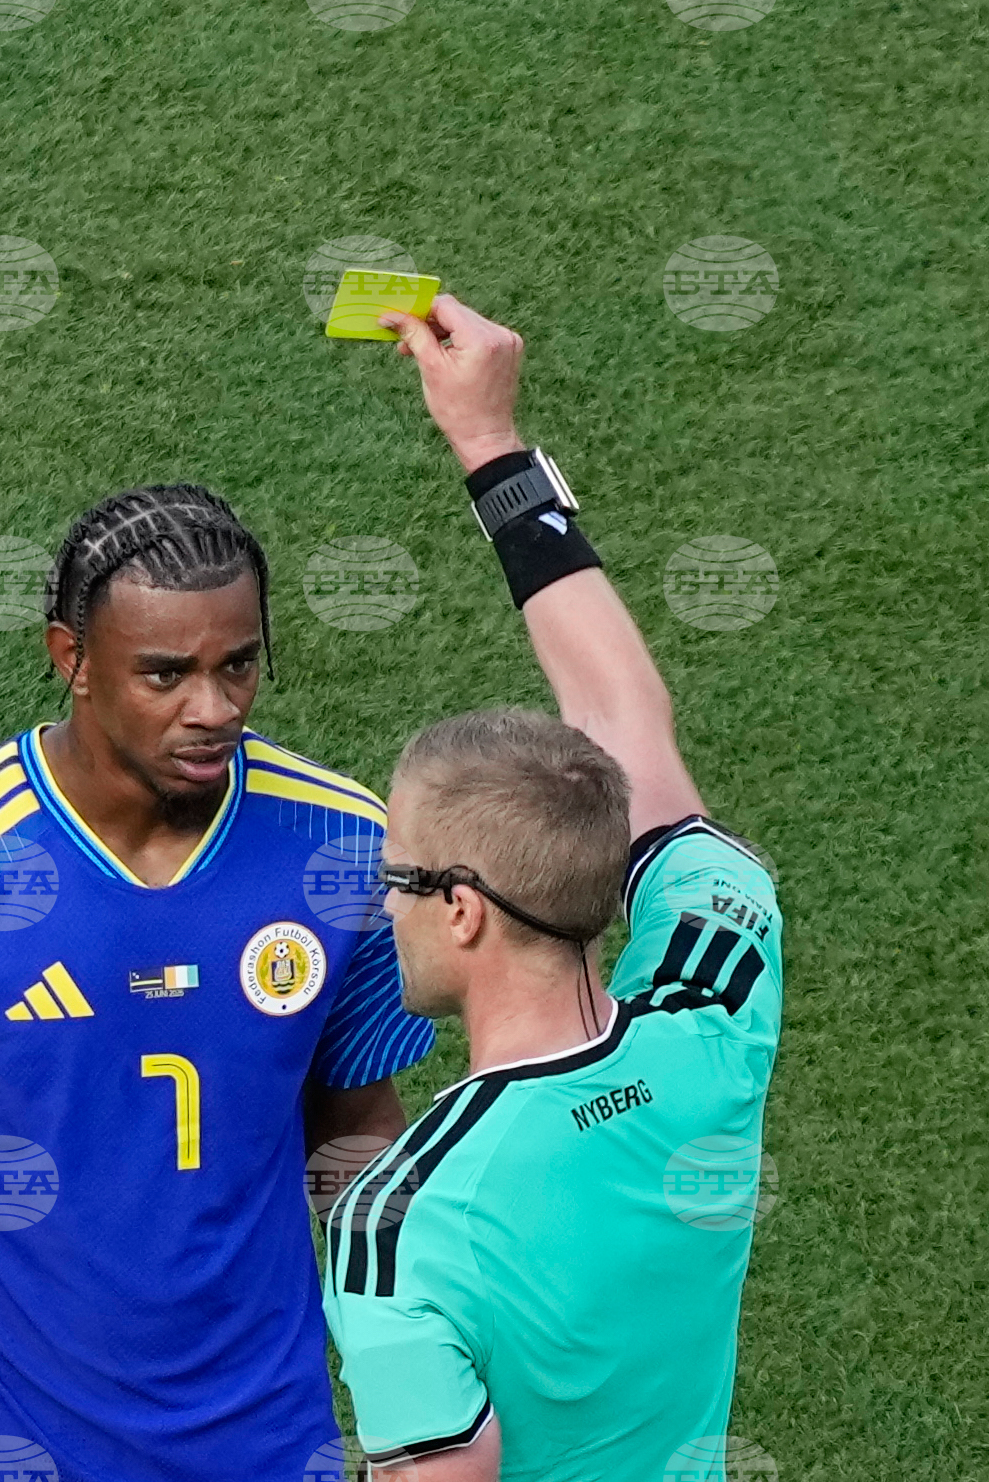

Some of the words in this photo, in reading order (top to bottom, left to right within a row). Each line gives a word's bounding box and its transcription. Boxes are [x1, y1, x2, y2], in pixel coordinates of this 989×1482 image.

[712, 895, 769, 942] FIFA
[141, 1054, 201, 1171] 7
[571, 1079, 653, 1132] NYBERG
